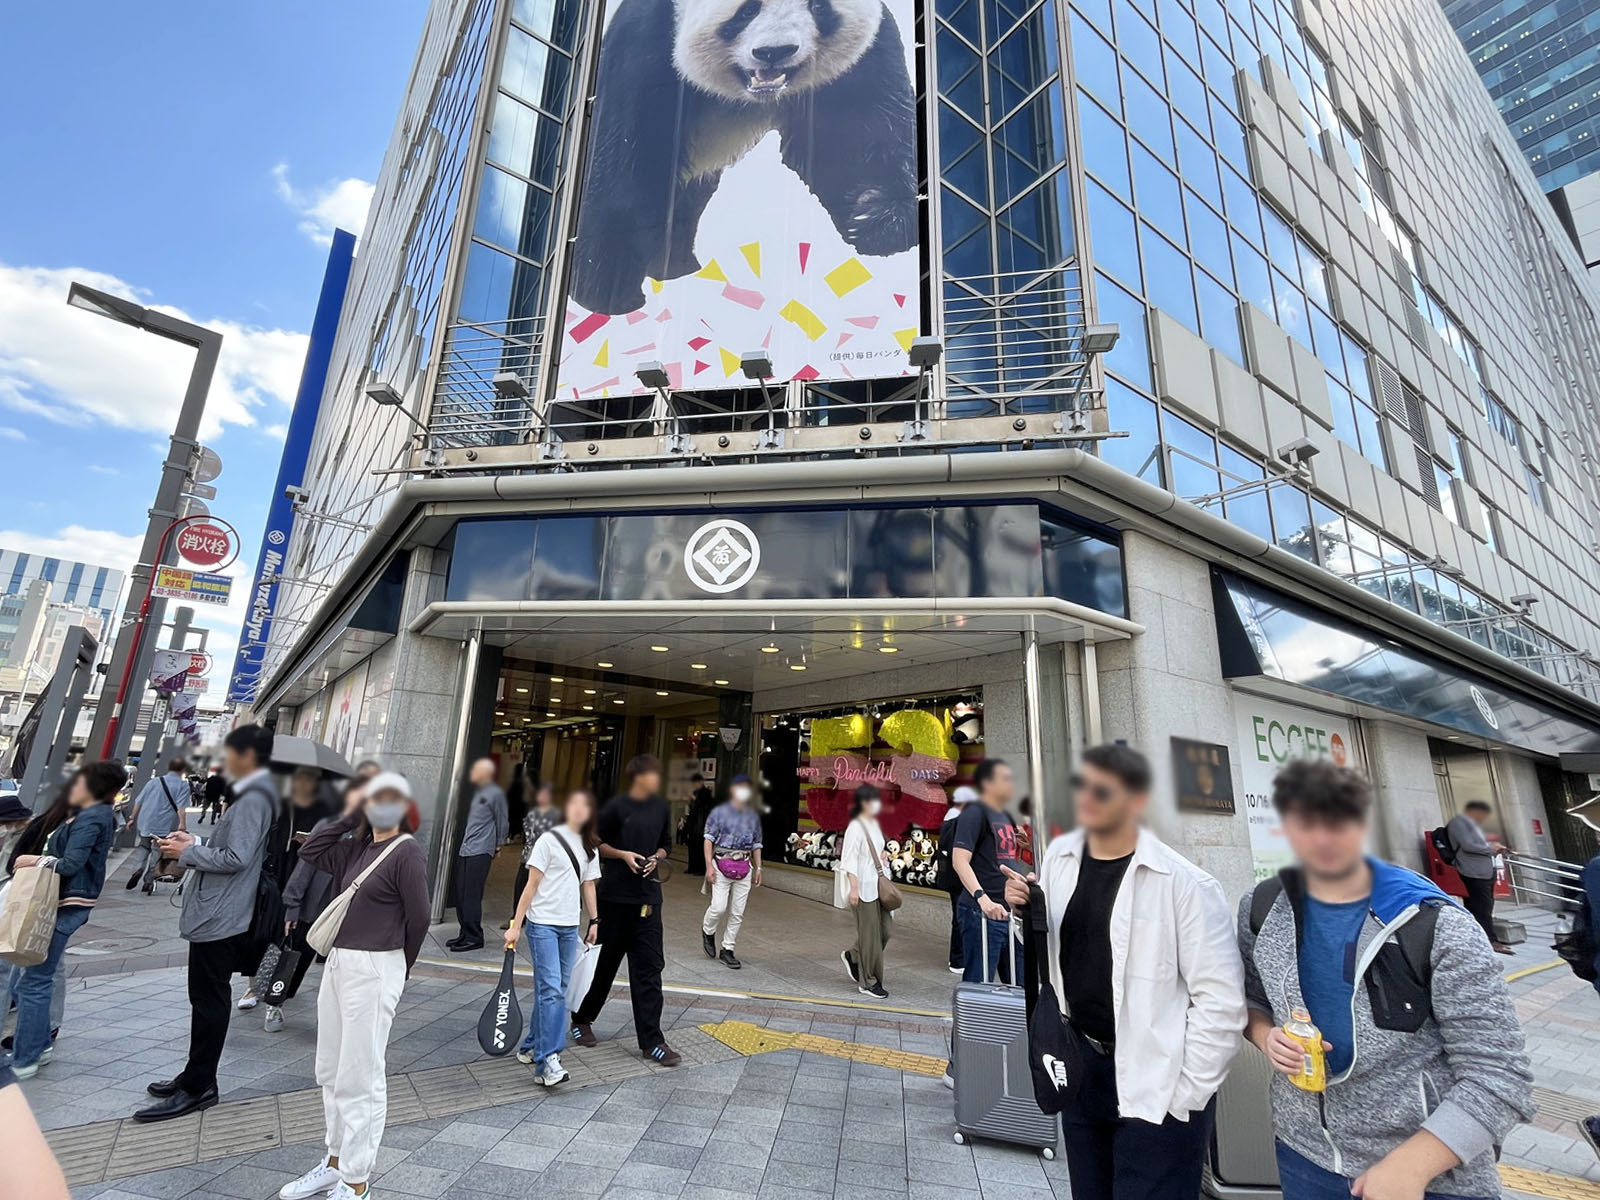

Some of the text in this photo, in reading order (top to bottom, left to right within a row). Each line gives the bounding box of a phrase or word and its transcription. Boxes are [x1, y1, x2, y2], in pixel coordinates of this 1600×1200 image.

[182, 532, 227, 556] 消火栓
[796, 756, 940, 790] HAPPY Pandaful DAYS
[495, 989, 511, 1025] YONEX
[1053, 1060, 1068, 1087] NIKE
